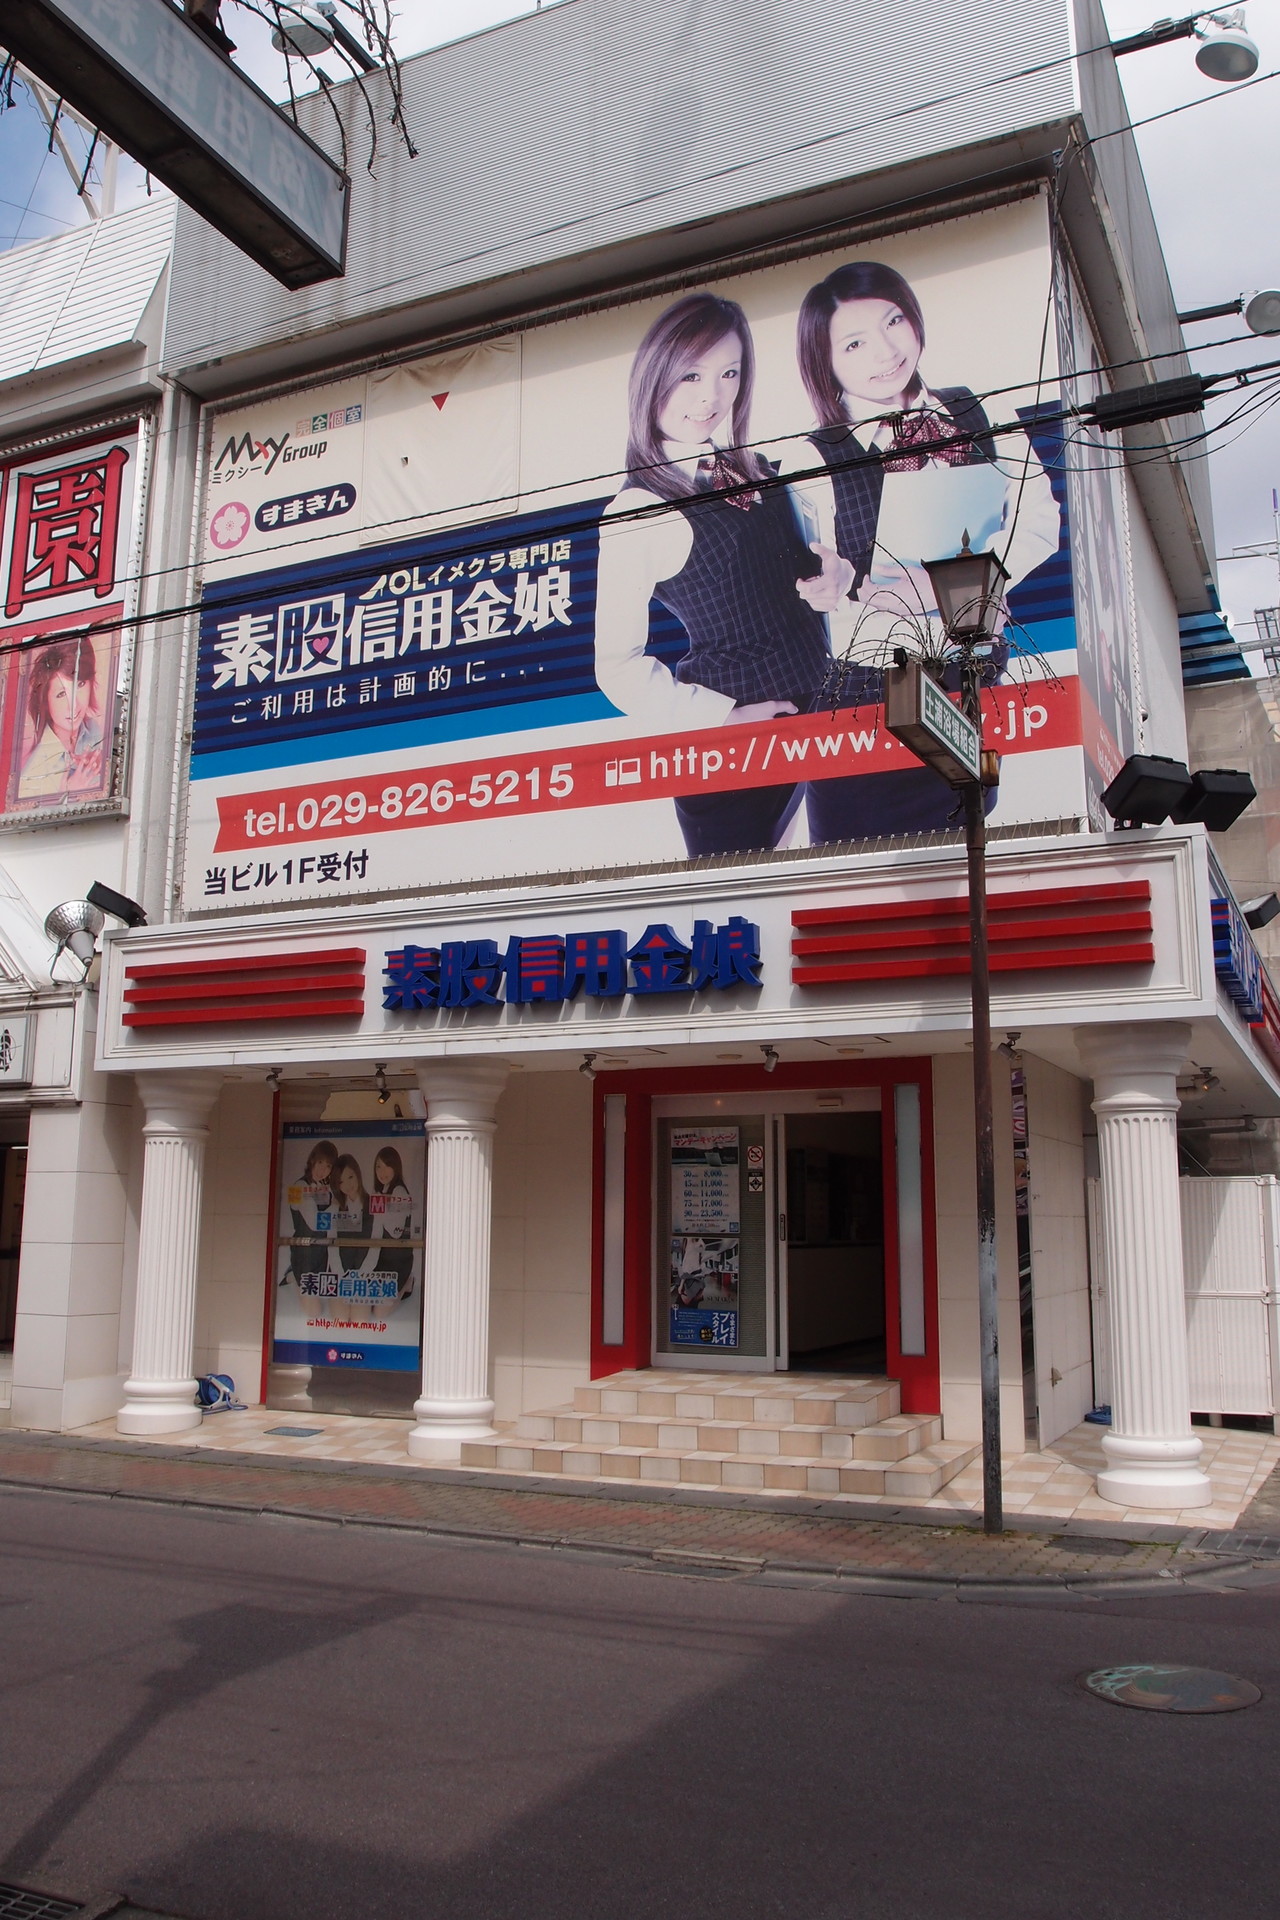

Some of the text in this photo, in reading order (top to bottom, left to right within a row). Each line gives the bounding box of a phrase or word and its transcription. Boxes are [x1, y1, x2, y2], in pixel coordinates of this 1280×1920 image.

[295, 404, 362, 438] 完全個室
[211, 465, 263, 485] ミクシー
[282, 440, 328, 464] Group
[3, 444, 131, 619] 園
[261, 489, 349, 526] すまきん
[388, 539, 572, 596] OLイメクラ専門店
[211, 565, 573, 690] 素股信用金娘
[650, 700, 1049, 780] http://www..jp
[925, 690, 977, 763] 土浦浴場組合
[243, 762, 575, 838] tel.029-826-5215
[203, 848, 370, 896] 当ビル1F受付
[381, 915, 764, 1011] 素股信用金娘
[301, 1273, 397, 1297] 素股信用金娘
[315, 1318, 387, 1332] http://www.mxy.jp
